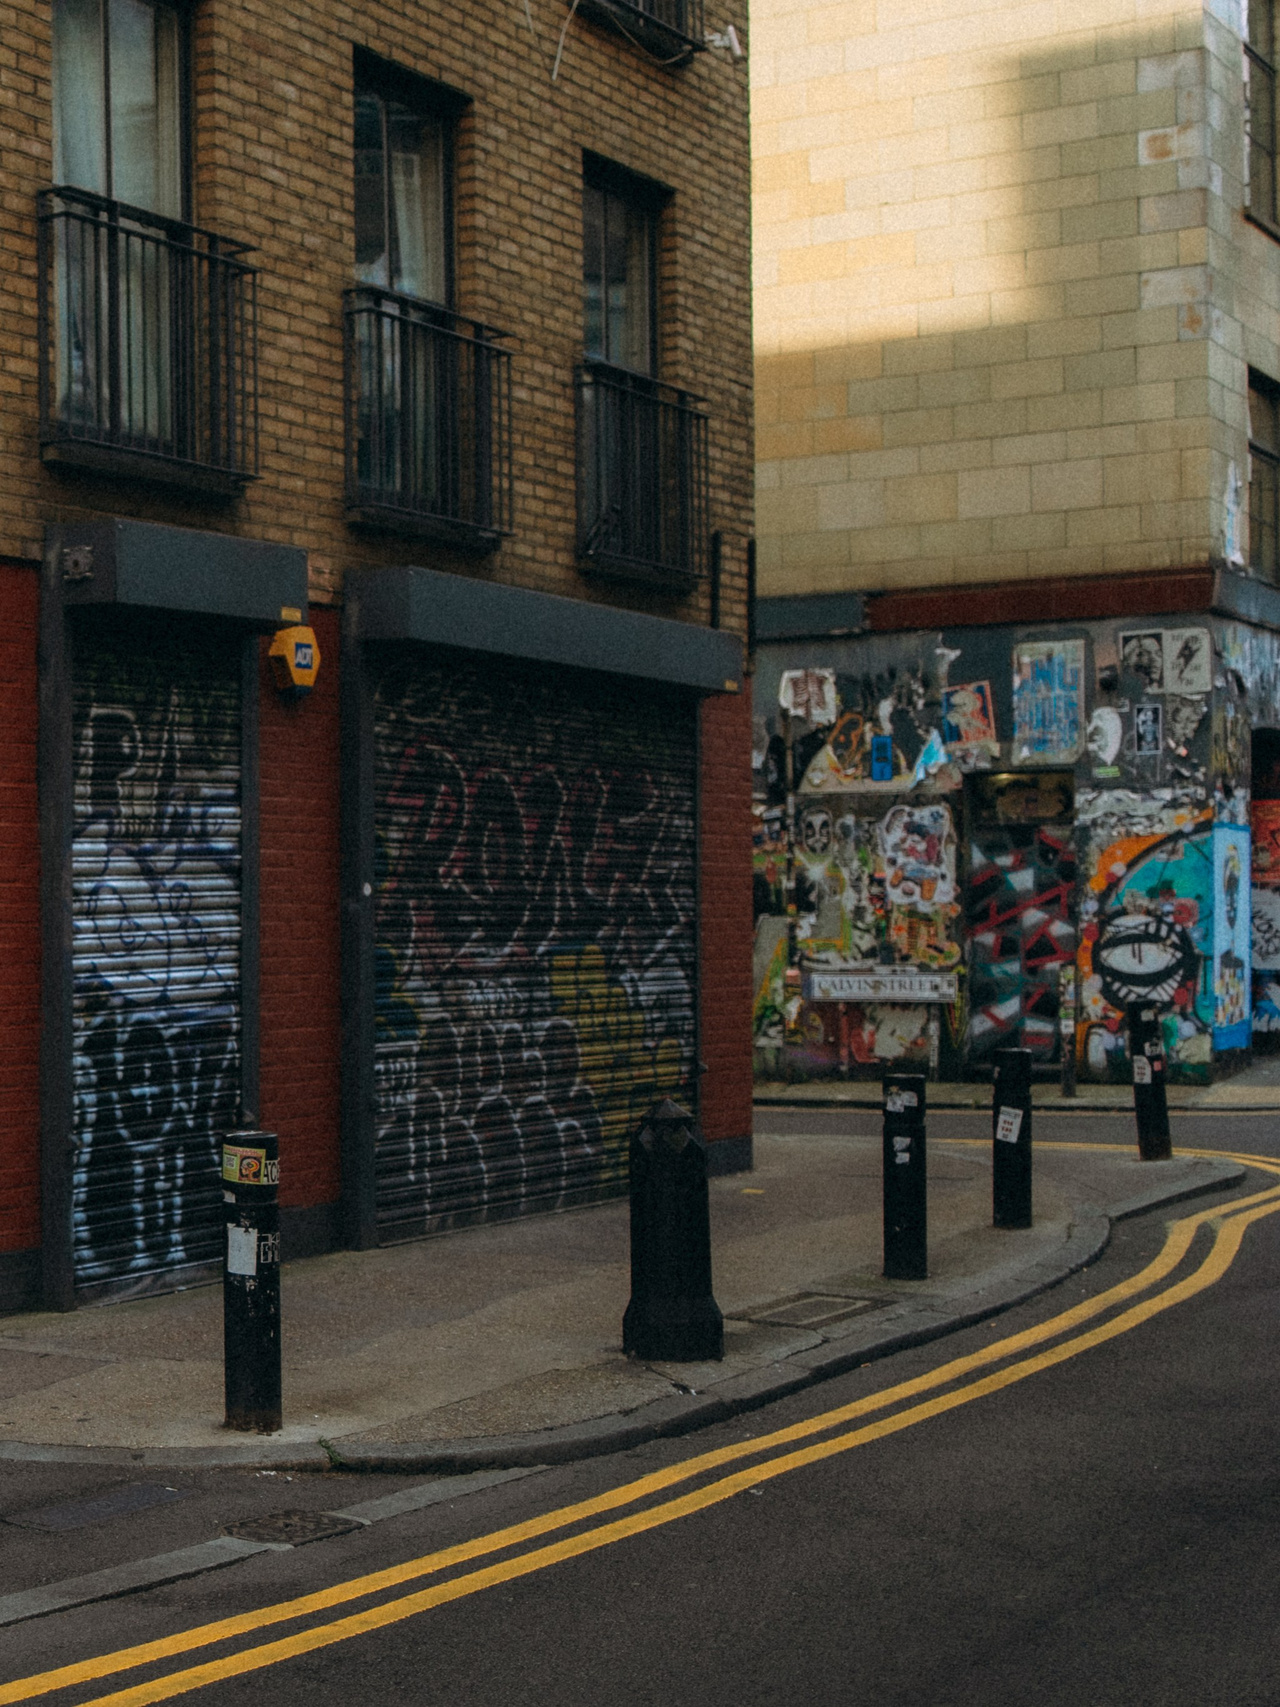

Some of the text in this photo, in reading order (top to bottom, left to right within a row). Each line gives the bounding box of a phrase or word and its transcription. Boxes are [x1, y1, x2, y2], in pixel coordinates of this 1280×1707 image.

[296, 648, 312, 664] ADT
[818, 978, 876, 991] CALVIN
[879, 978, 937, 991] STREET
